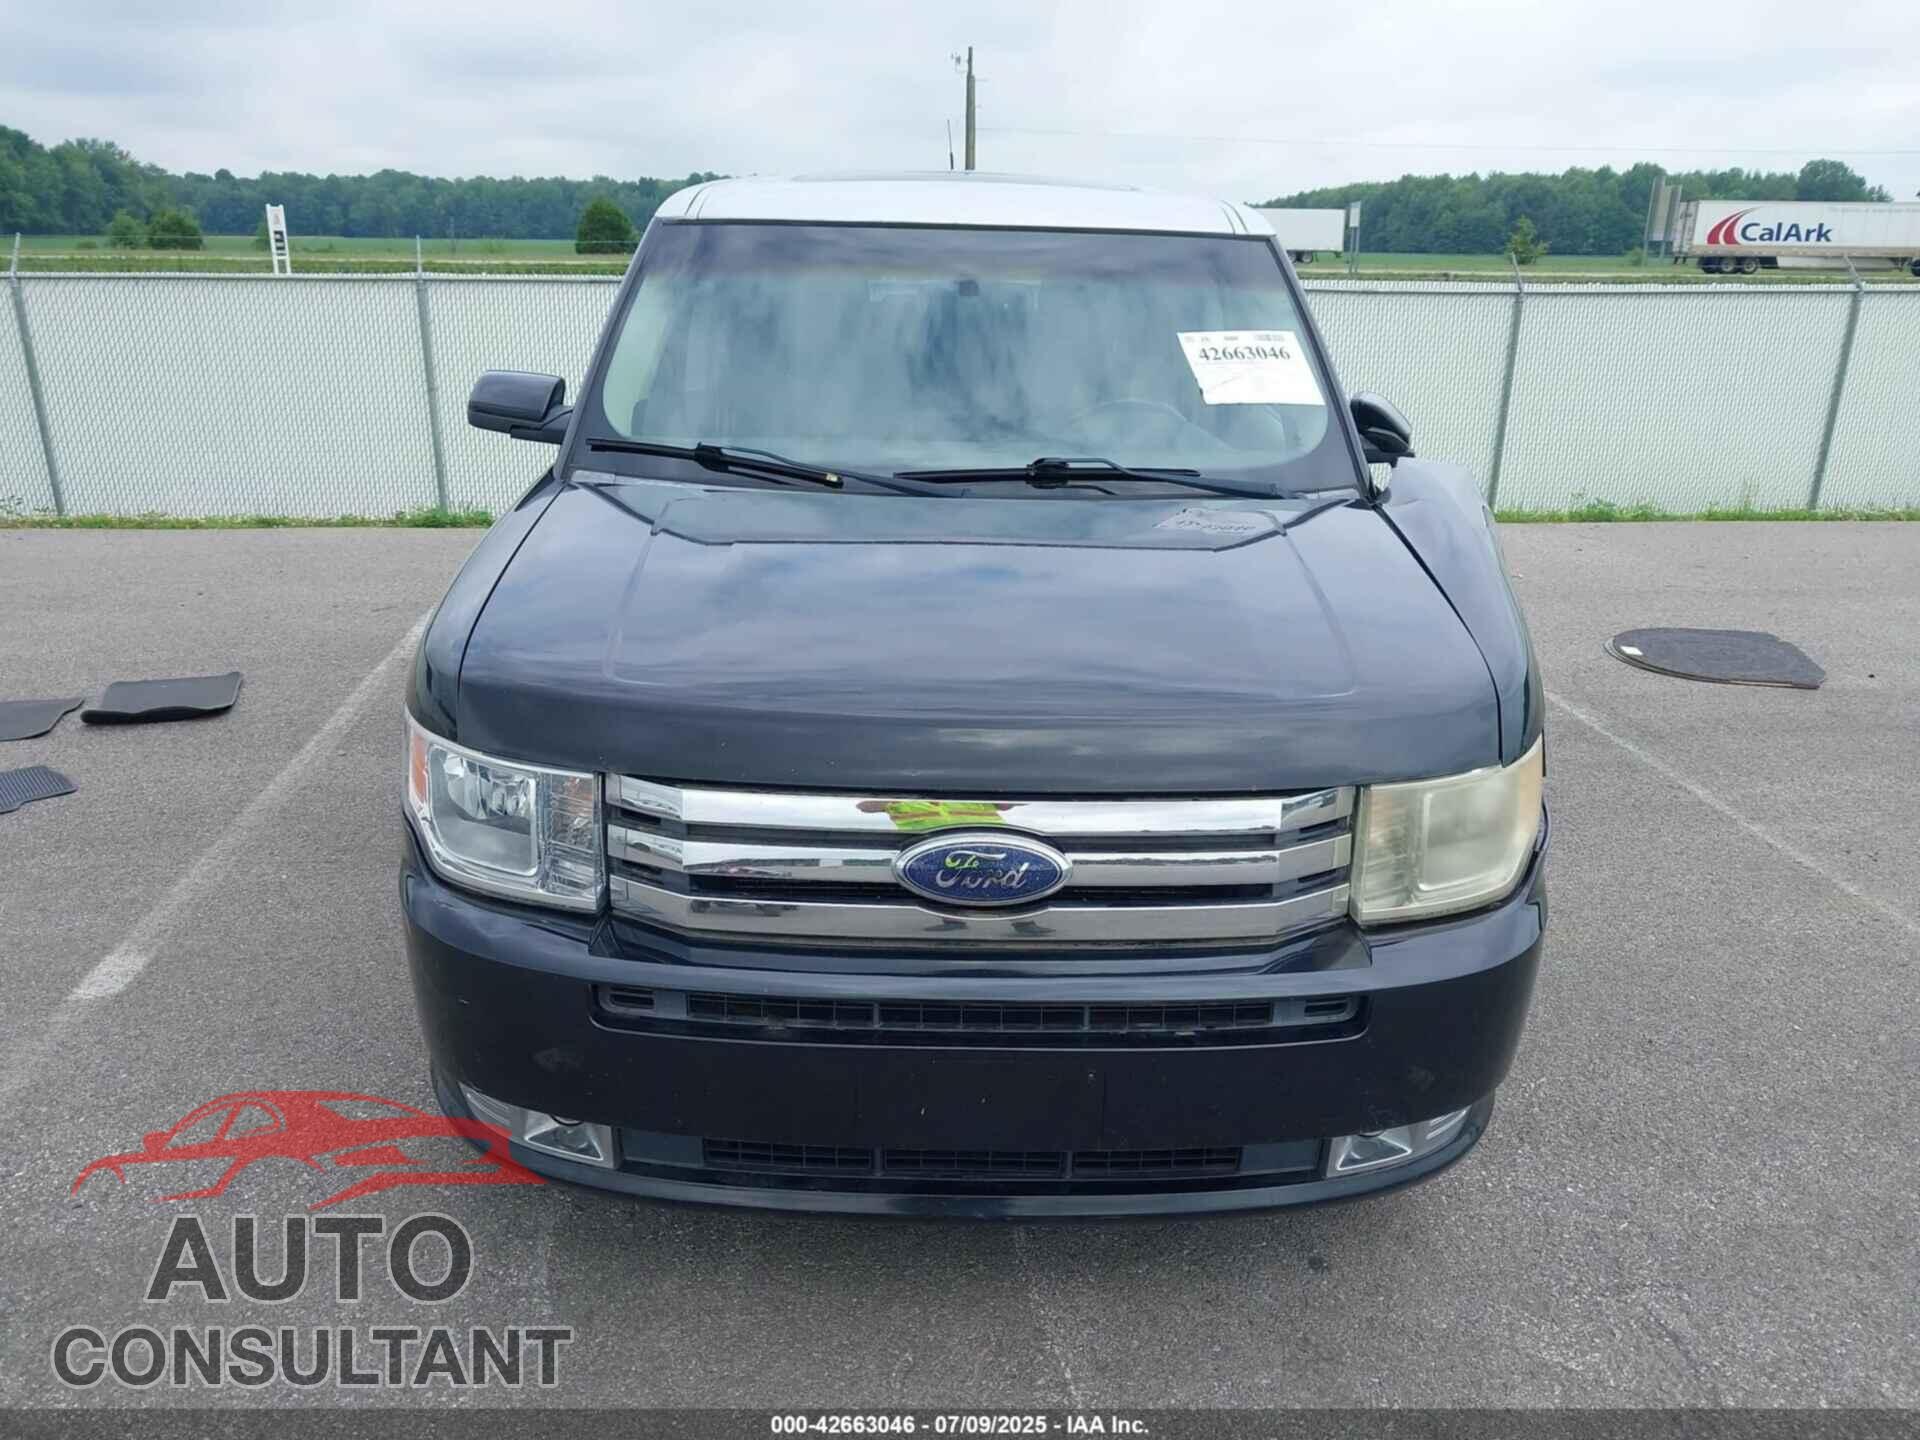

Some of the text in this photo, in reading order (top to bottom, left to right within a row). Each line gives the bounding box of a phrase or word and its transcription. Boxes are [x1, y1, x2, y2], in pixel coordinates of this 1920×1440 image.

[1740, 222, 1833, 242] CalArk
[1198, 346, 1291, 361] 42663046
[936, 850, 1029, 889] Ford
